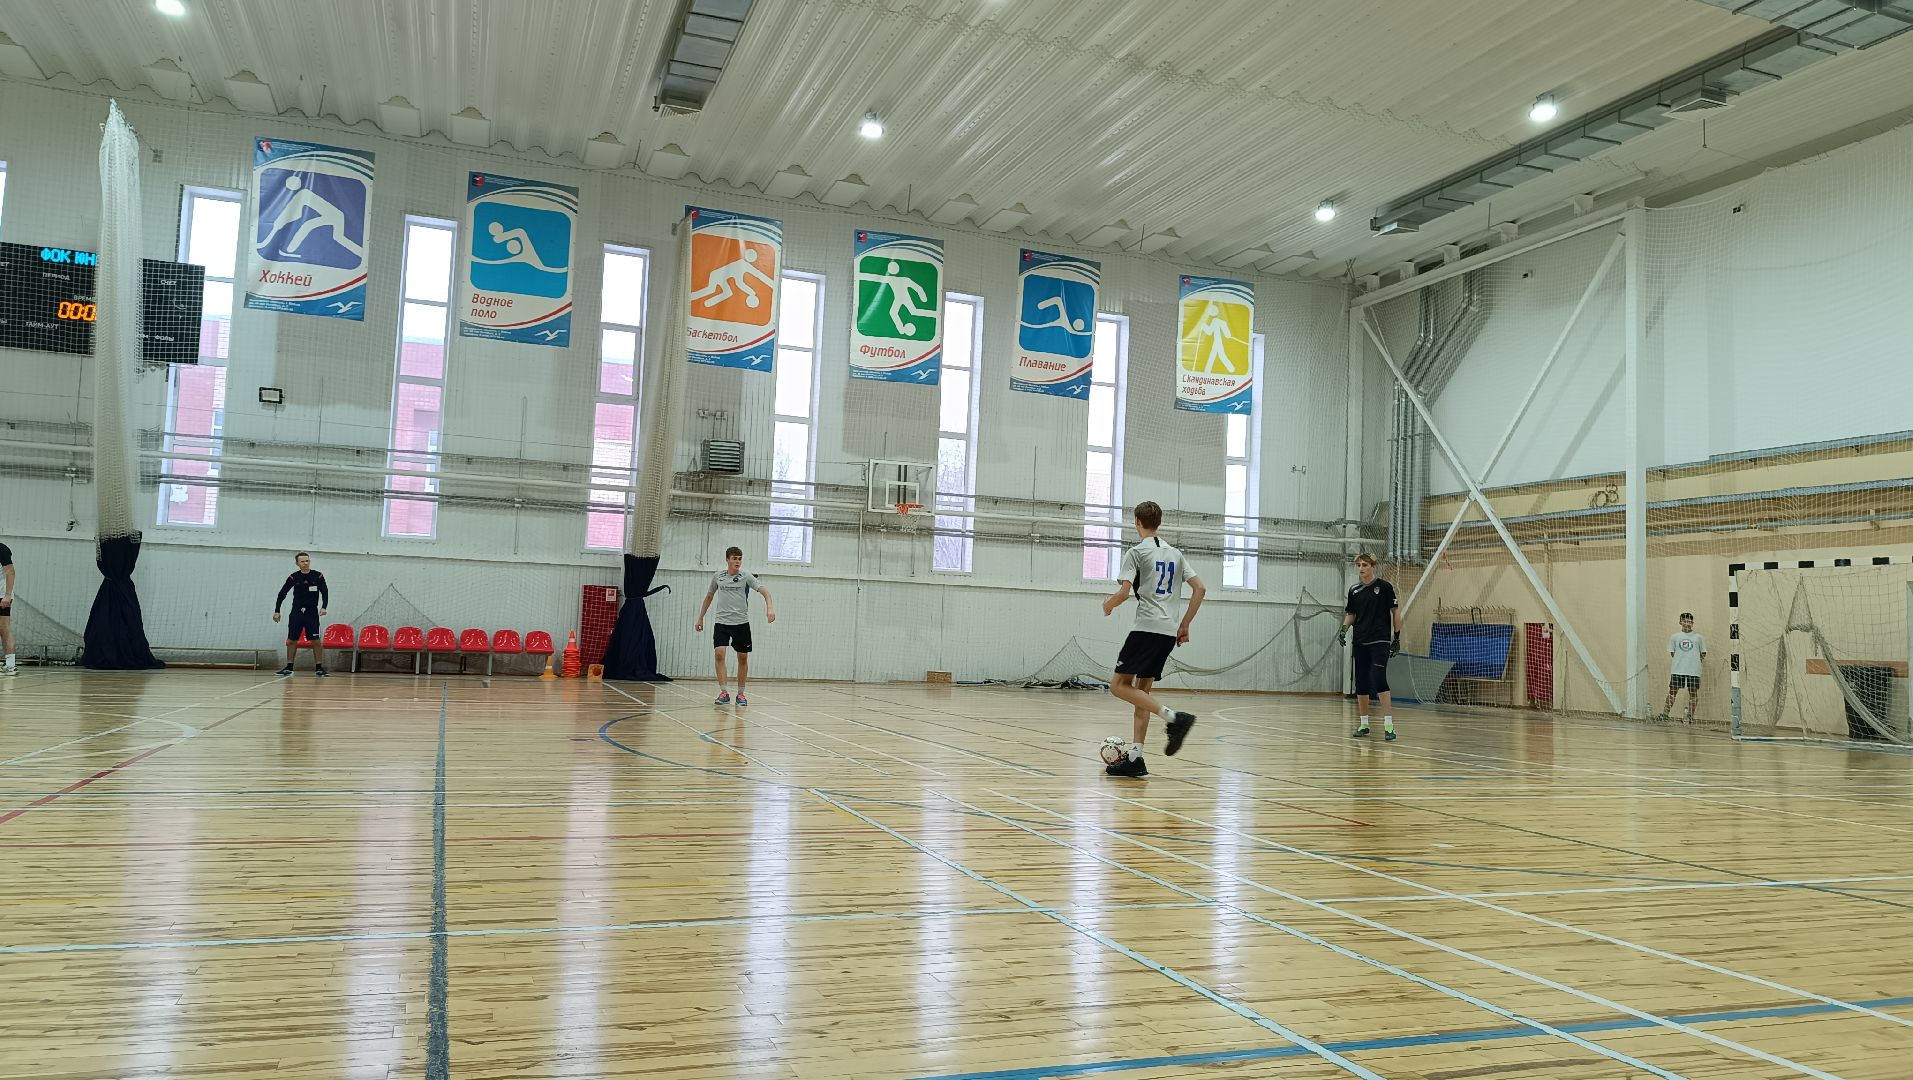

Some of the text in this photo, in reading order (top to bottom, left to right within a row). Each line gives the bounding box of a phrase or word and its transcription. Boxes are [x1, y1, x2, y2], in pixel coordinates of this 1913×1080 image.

[41, 248, 97, 266] ФОК ЮН
[42, 272, 70, 280] ПЕРИОД
[259, 270, 312, 286] Хоккей
[471, 293, 513, 307] Водное
[470, 308, 497, 319] поло
[25, 321, 59, 329] ТАЙМ-АУТ
[687, 327, 738, 343] Баскетбол
[860, 345, 906, 358] Футбол
[1019, 356, 1067, 371] Плавание
[1183, 374, 1236, 387] Скандинавская
[1182, 386, 1206, 396] ходьба
[1155, 561, 1175, 594] 21
